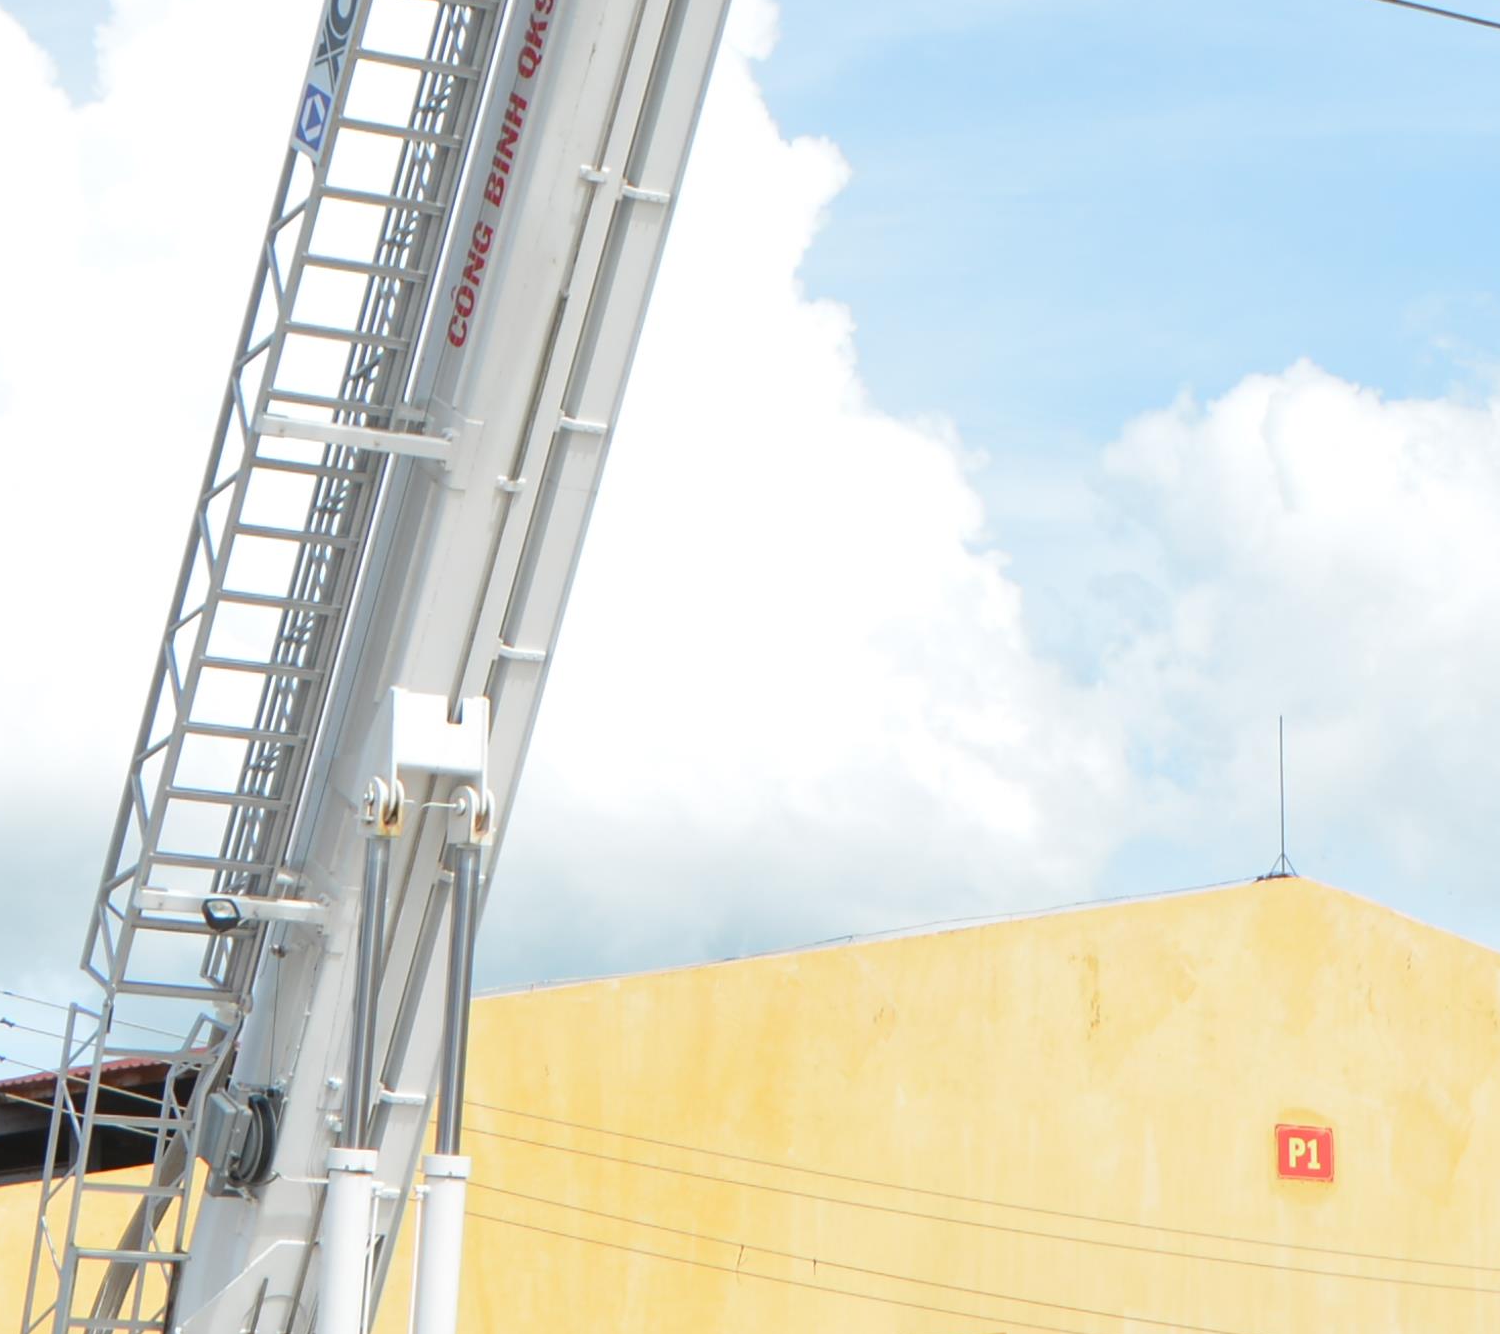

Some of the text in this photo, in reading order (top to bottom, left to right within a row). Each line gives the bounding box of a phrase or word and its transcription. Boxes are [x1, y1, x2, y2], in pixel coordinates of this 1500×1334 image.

[447, 220, 494, 349] CÔNG
[483, 98, 529, 209] BINH
[1288, 1137, 1321, 1170] P1
